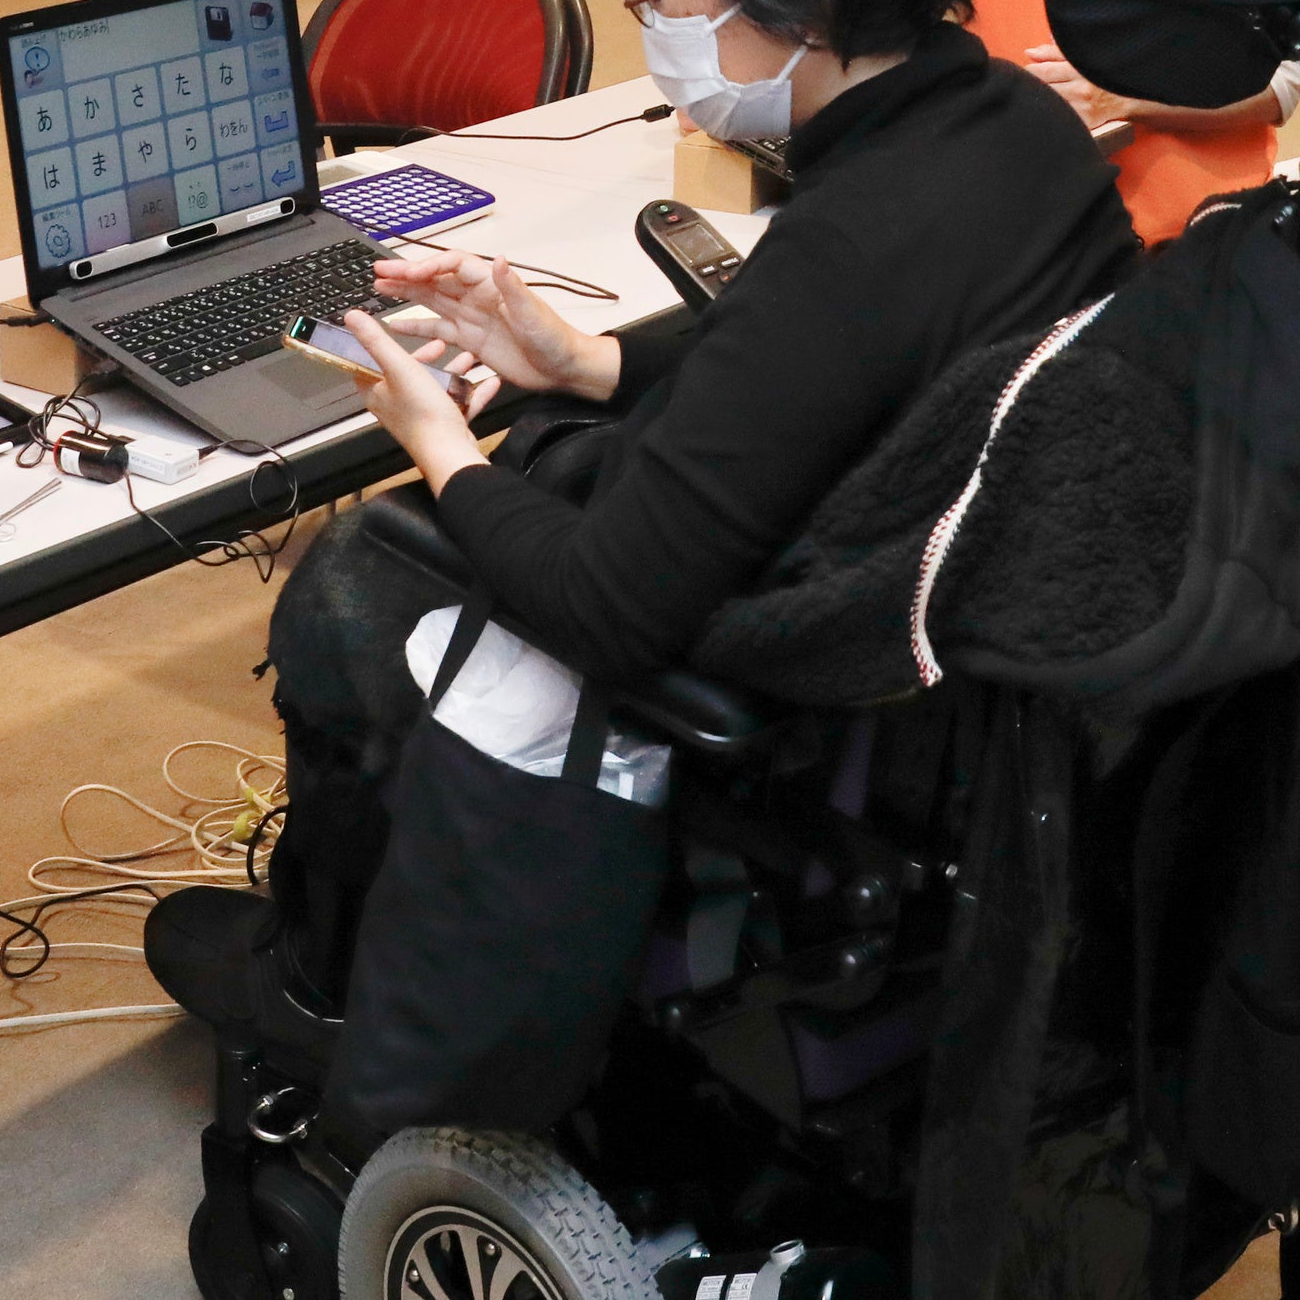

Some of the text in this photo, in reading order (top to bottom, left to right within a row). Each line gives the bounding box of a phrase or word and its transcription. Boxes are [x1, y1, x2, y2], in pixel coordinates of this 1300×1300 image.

[36, 61, 235, 133] あ か さ た な
[43, 118, 249, 190] は ま や ら わをん
[97, 212, 118, 230] 123
[141, 198, 164, 215] ABC
